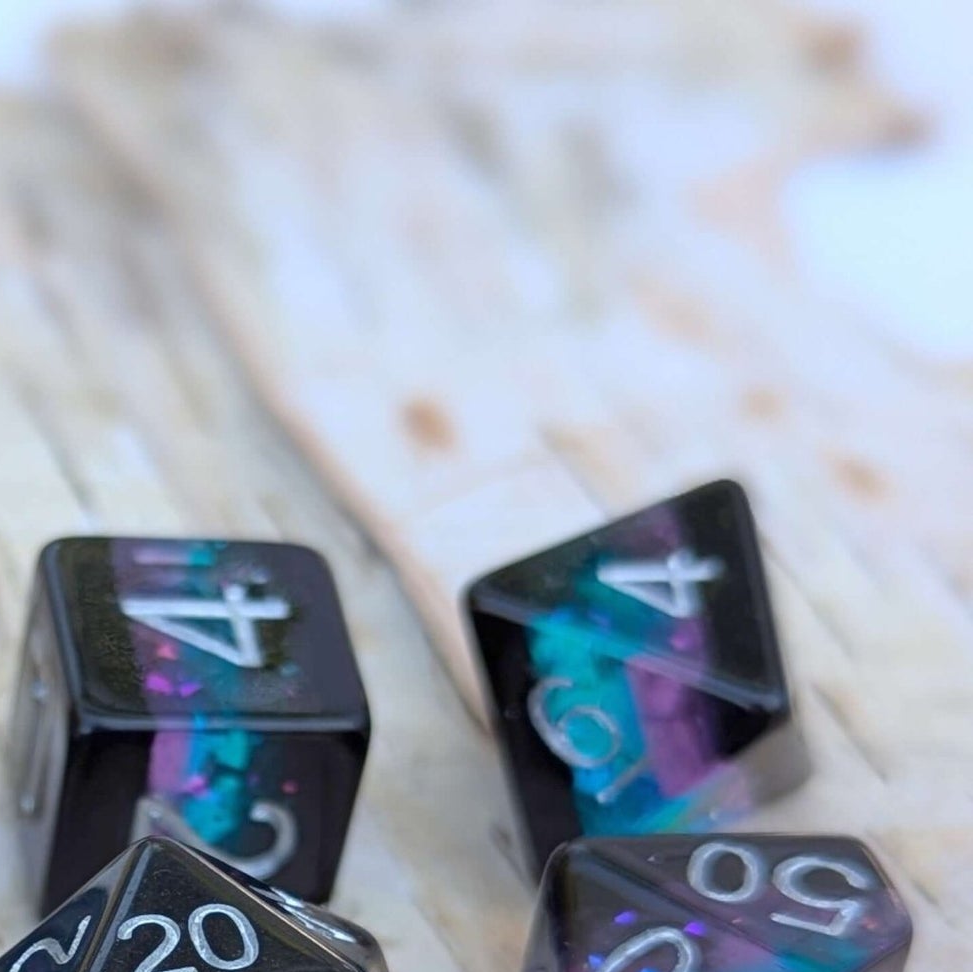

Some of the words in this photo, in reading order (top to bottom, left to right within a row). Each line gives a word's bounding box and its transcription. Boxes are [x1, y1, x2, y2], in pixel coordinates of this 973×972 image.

[596, 547, 726, 618] 4
[120, 583, 292, 668] 4
[686, 841, 874, 937] 50
